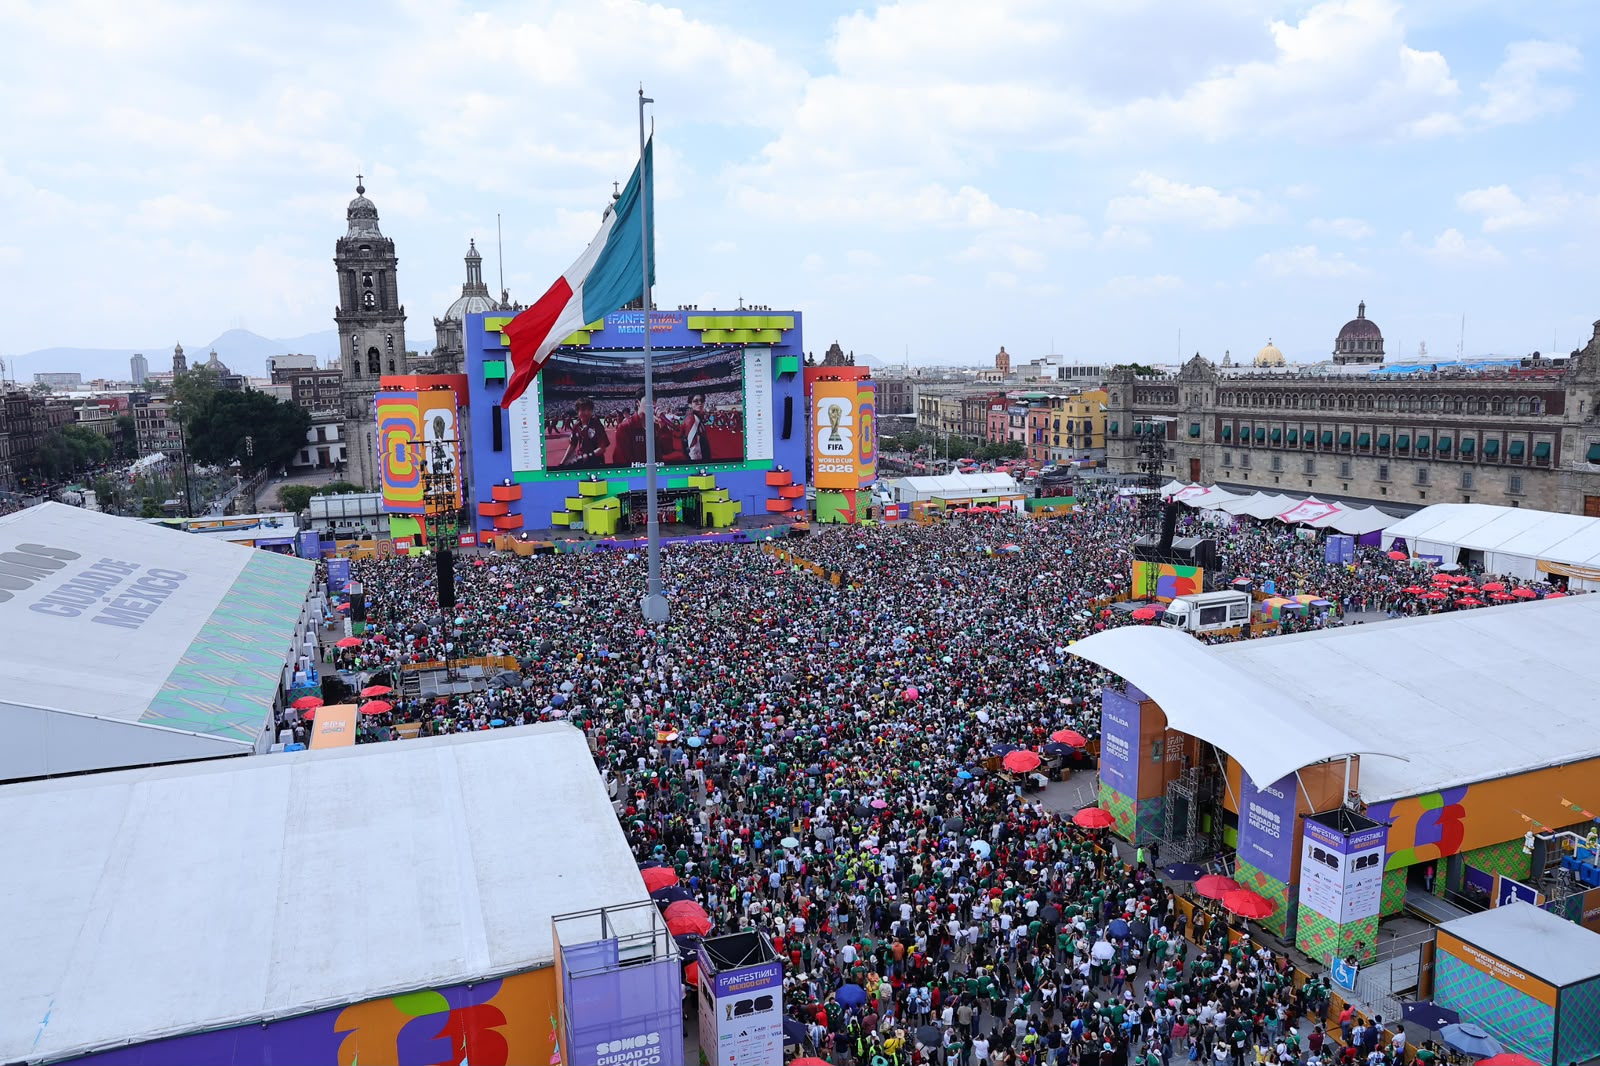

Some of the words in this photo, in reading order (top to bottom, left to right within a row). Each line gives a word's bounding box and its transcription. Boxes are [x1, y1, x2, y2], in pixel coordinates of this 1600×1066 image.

[618, 325, 651, 334] MEXIC
[828, 443, 844, 451] FIFA
[818, 464, 854, 474] 2026
[29, 571, 123, 618] CIUDAD
[89, 557, 141, 577] DE
[91, 568, 188, 630] MÉXICO
[1108, 713, 1129, 728] SALIDA
[1249, 801, 1281, 825] SOMOS
[1249, 811, 1272, 828] CIUDAD
[1271, 823, 1281, 833] DE
[1462, 945, 1495, 965] SERVICIO
[1495, 961, 1526, 980] MÉDICO
[729, 980, 755, 991] MEXICO
[755, 977, 771, 987] CITY
[734, 994, 774, 1017] 26
[596, 1031, 660, 1056] SOMOS
[597, 1049, 643, 1066] CIUDAD
[645, 1046, 660, 1057] DE
